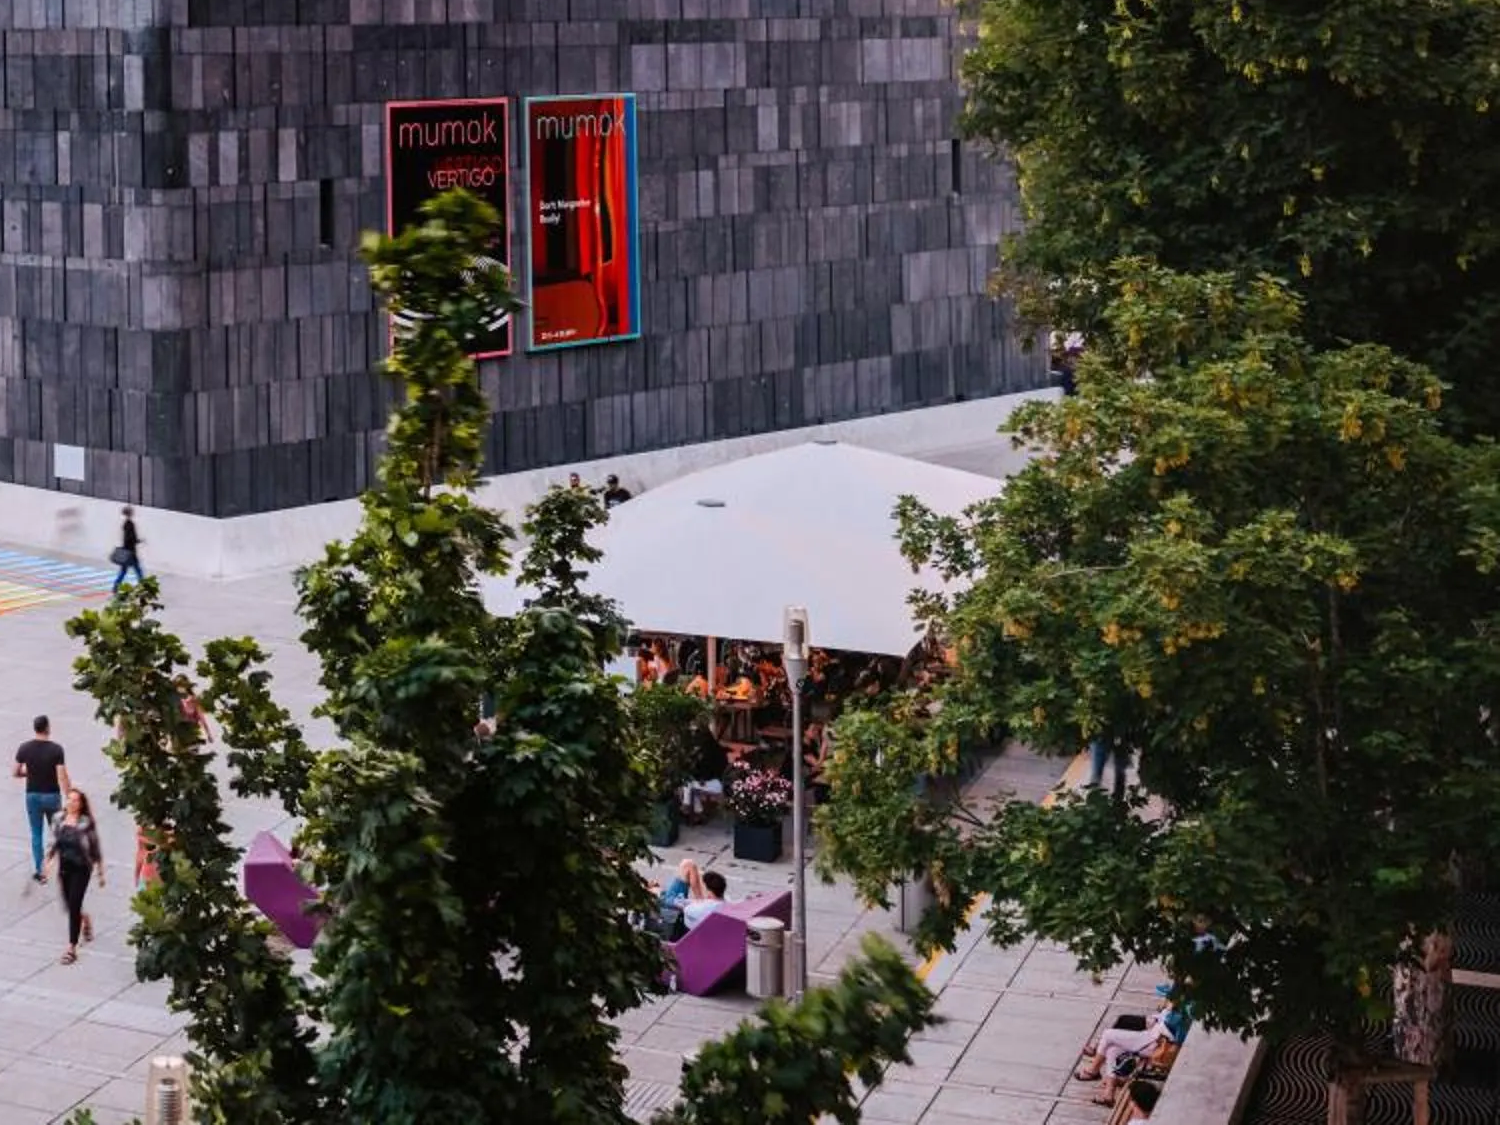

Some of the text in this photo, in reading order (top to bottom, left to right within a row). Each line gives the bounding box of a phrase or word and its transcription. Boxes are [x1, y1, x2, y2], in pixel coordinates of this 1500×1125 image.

[399, 112, 497, 147] mumok
[536, 112, 627, 140] mumok
[427, 166, 496, 190] VERTIGO
